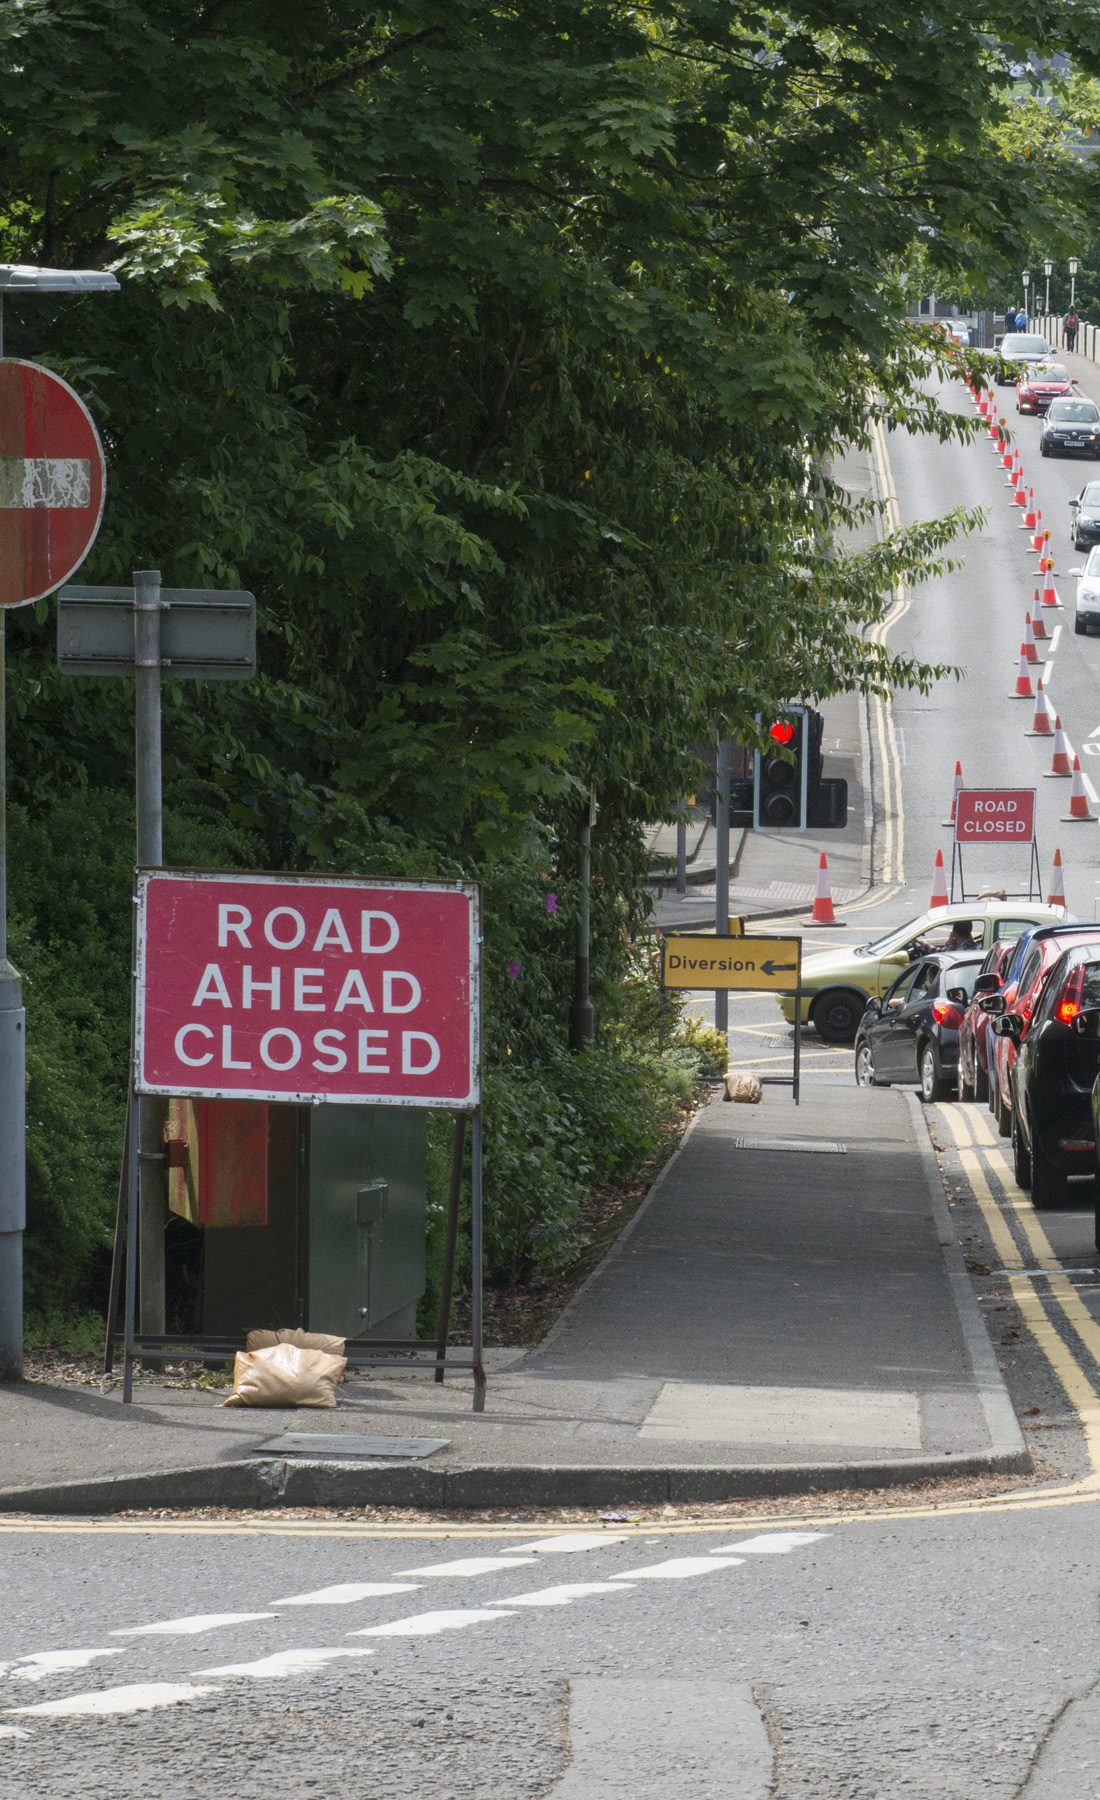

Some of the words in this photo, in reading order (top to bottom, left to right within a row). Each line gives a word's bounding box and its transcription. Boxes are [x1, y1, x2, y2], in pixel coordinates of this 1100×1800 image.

[974, 800, 1018, 812] ROAD
[963, 820, 1026, 832] CLOSED
[217, 903, 400, 954] ROAD
[668, 954, 756, 971] Diversion
[191, 963, 422, 1015] AHEAD
[174, 1023, 441, 1075] CLOSED
